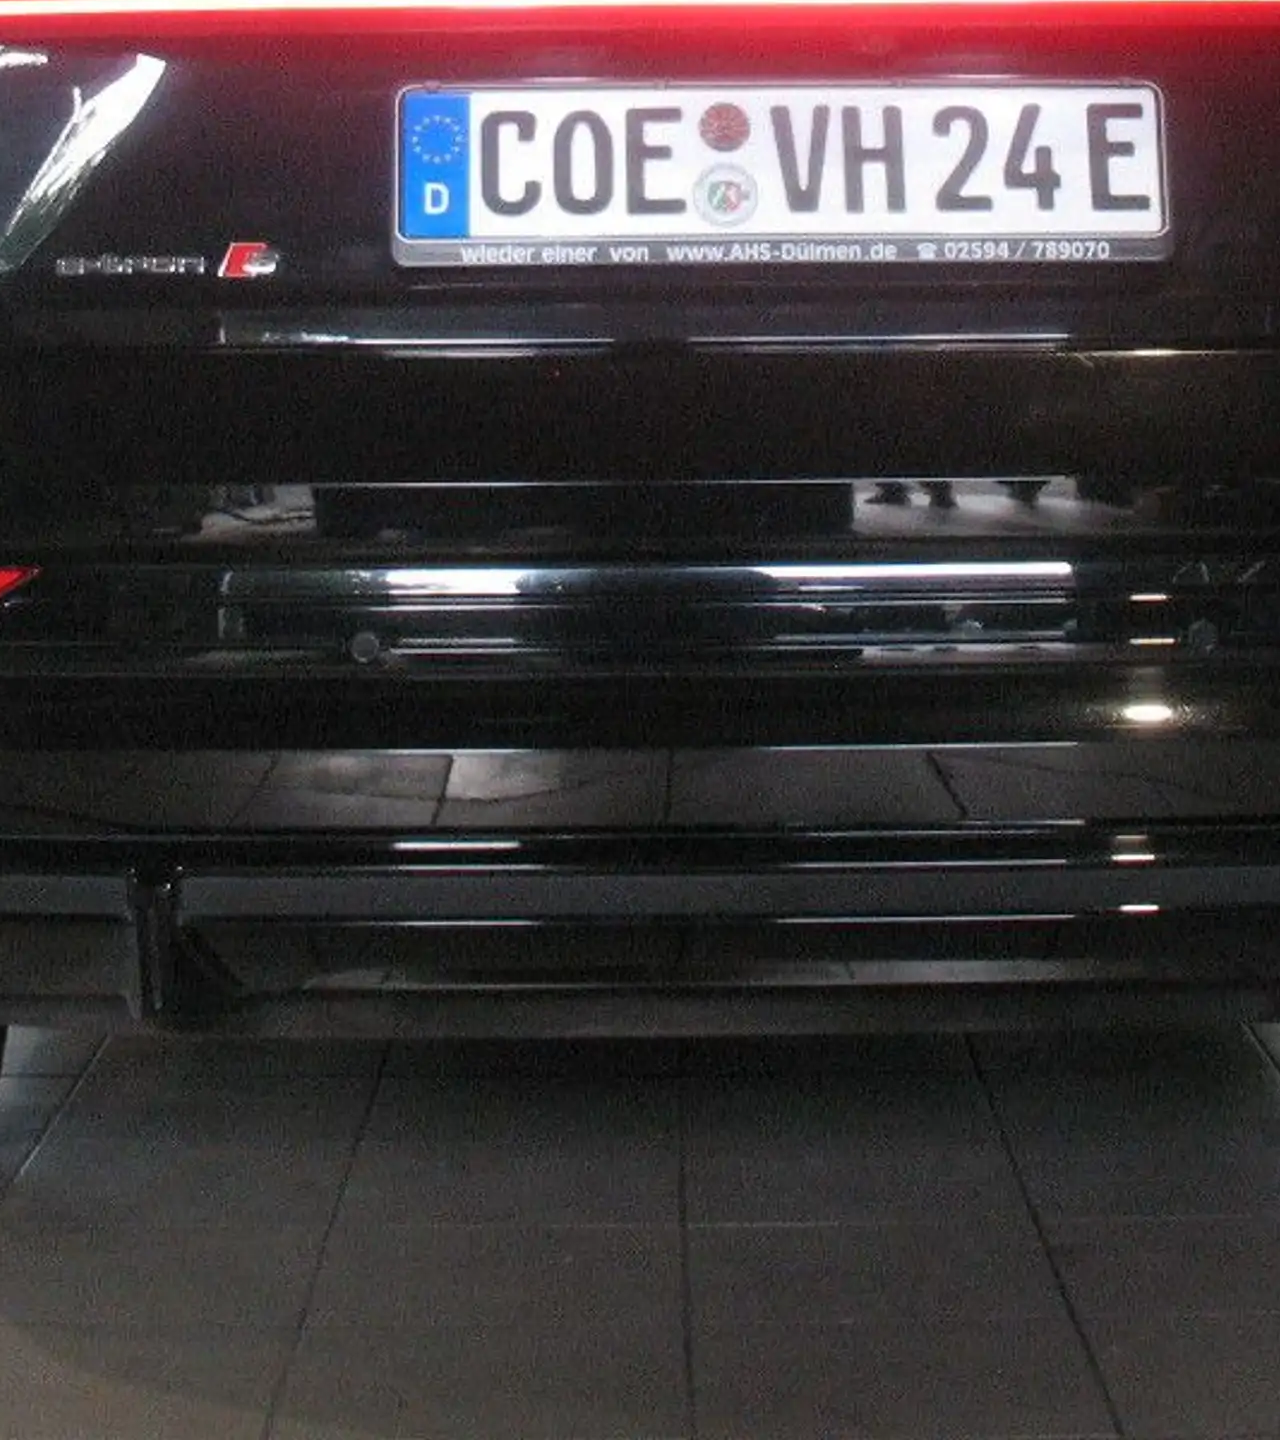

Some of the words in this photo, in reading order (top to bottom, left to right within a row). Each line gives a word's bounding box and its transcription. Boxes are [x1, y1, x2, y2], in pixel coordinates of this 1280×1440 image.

[481, 109, 686, 216] COE
[424, 183, 449, 214] D
[542, 245, 597, 262] einer
[609, 246, 649, 261] von
[666, 242, 898, 262] www.AHS-Dülmen.de
[944, 241, 1010, 259] 02594
[1032, 240, 1110, 259] 789070
